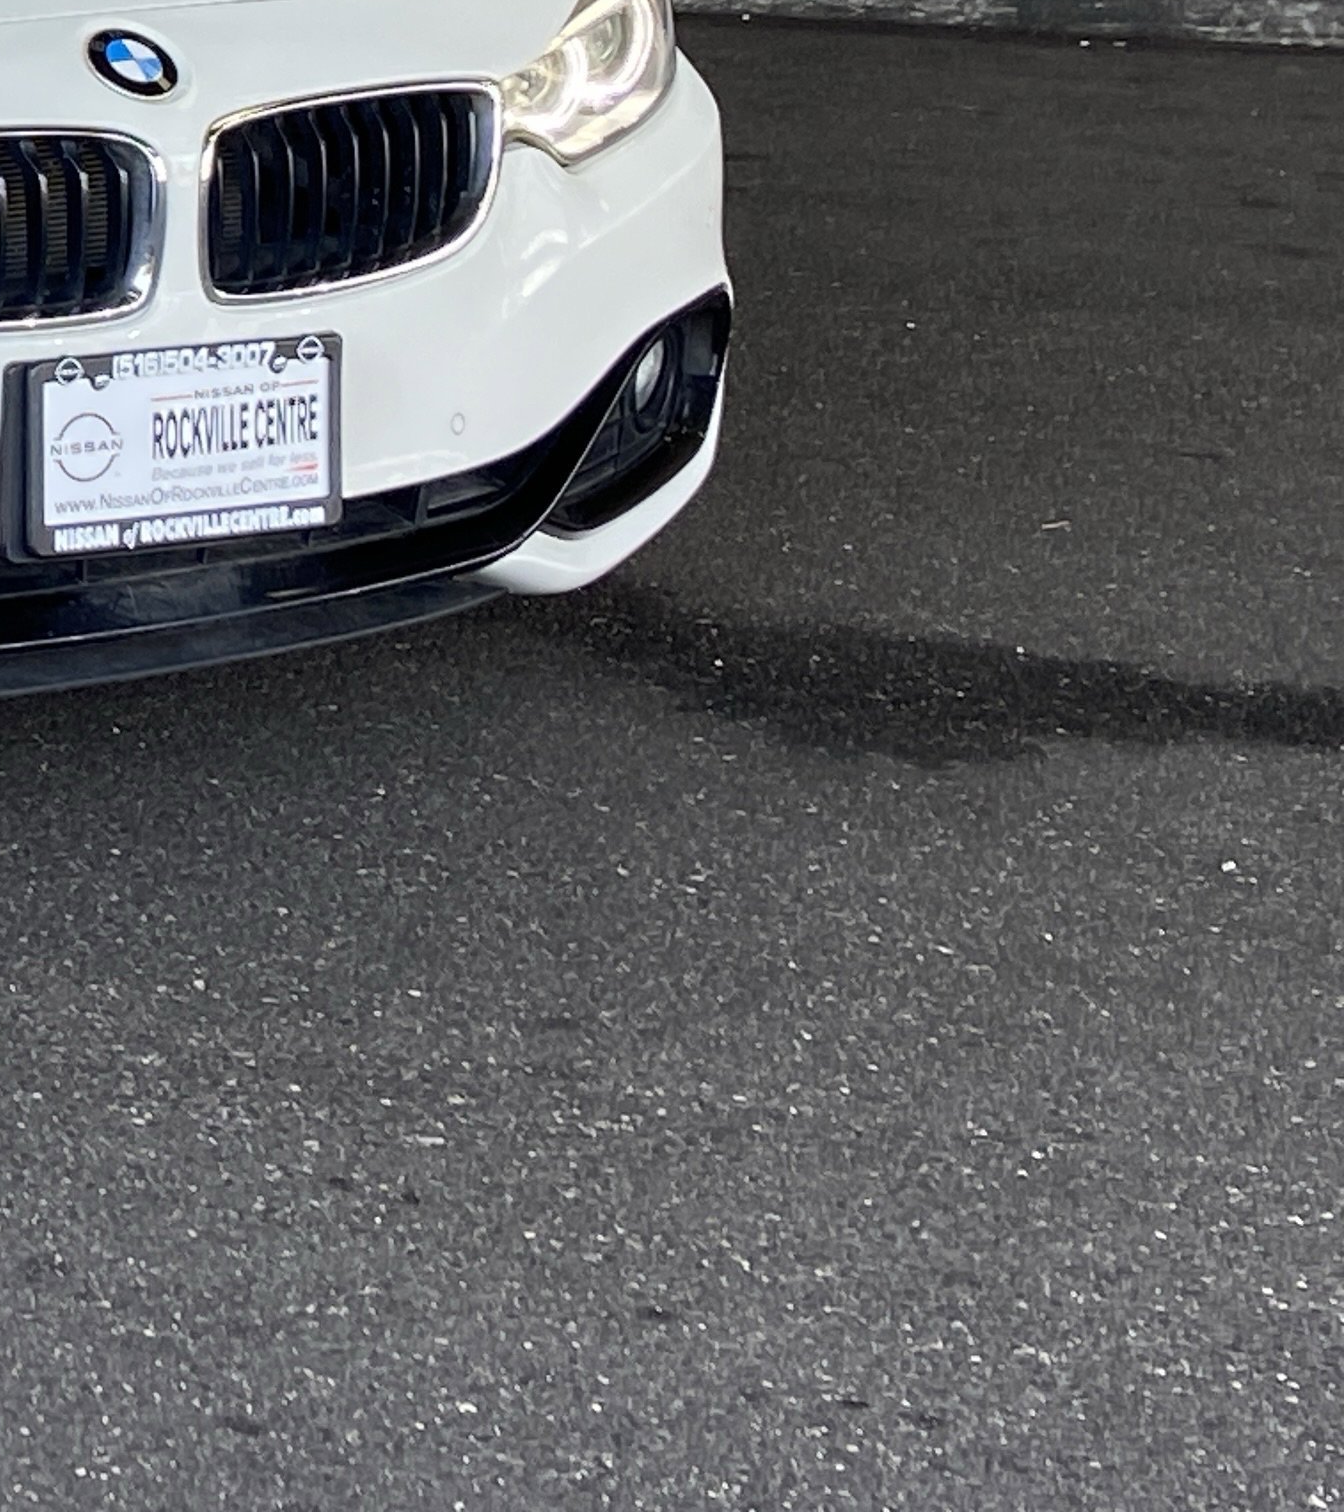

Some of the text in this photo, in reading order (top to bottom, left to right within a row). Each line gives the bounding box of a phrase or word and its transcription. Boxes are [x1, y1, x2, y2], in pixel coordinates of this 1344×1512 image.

[194, 384, 255, 400] NISSAN
[151, 393, 319, 460] ROCKVILLE CENTRE
[50, 437, 124, 457] NISSAN
[54, 523, 120, 553] NISSAN
[139, 504, 326, 544] ROCKVILLECENTRE.com
